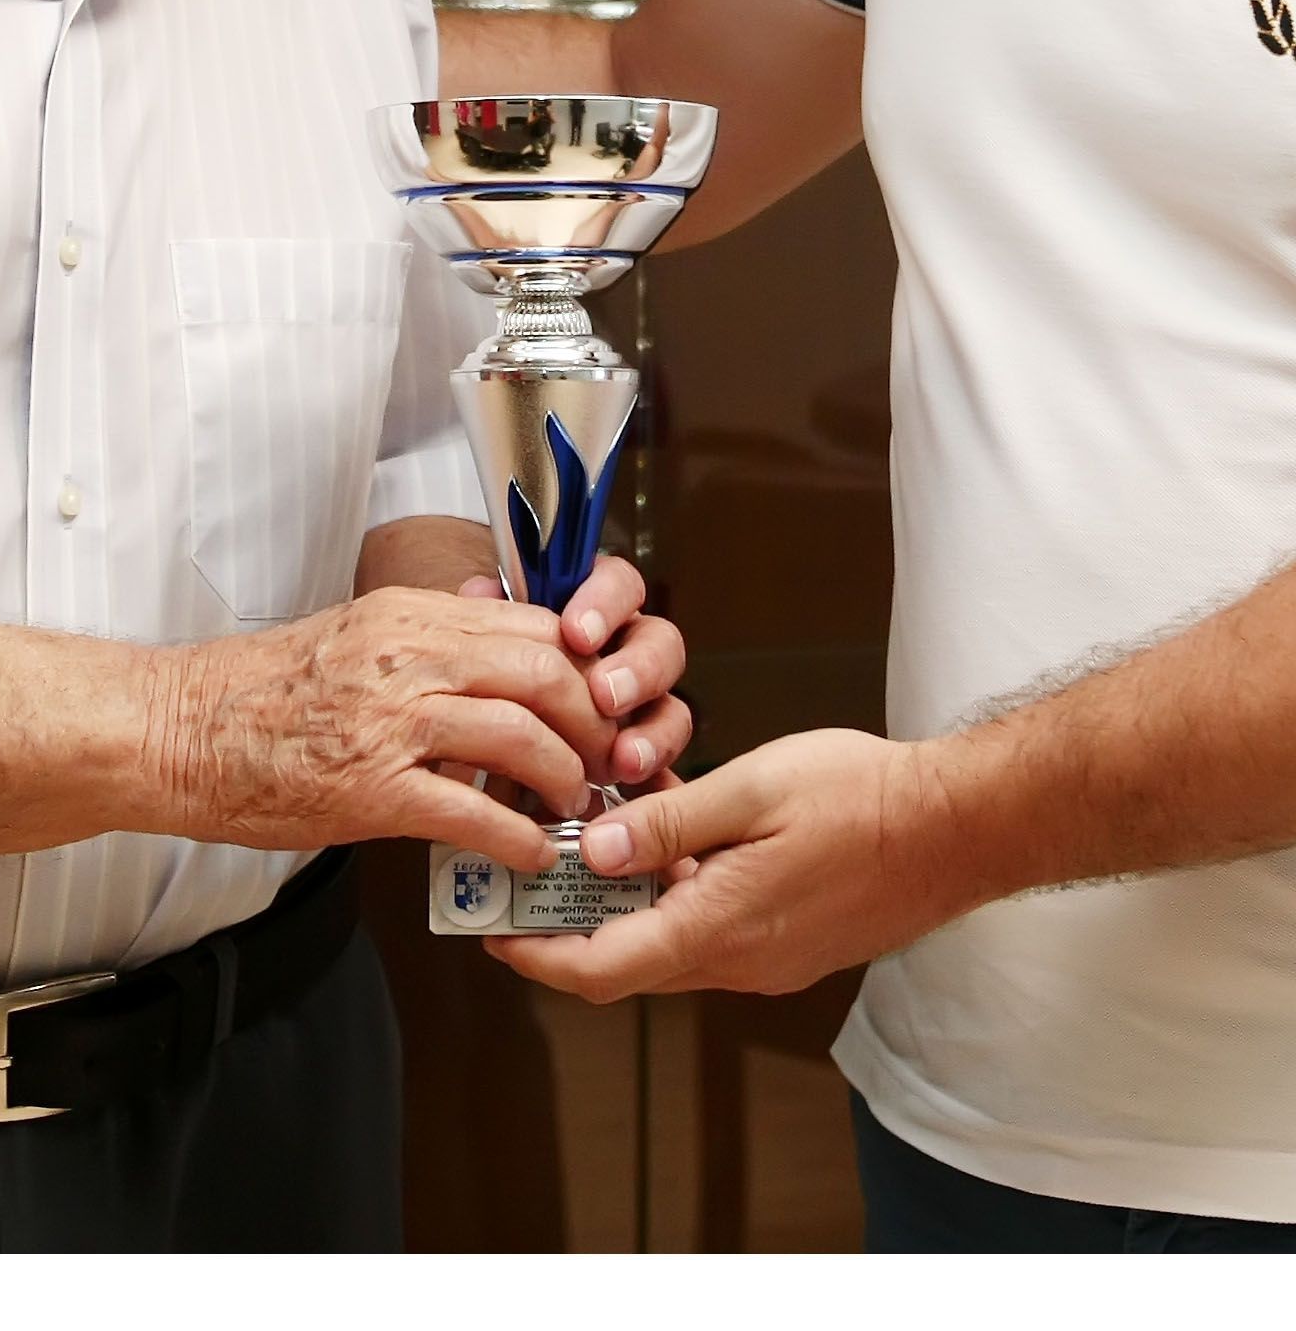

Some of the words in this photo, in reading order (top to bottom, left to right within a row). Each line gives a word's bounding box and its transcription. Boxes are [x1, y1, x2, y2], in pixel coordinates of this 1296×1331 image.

[573, 894, 606, 903] ΣΕΓΑΣ
[529, 905, 550, 915] ΣΤΗ
[562, 916, 605, 925] ΑΝΔΡΩΝ
